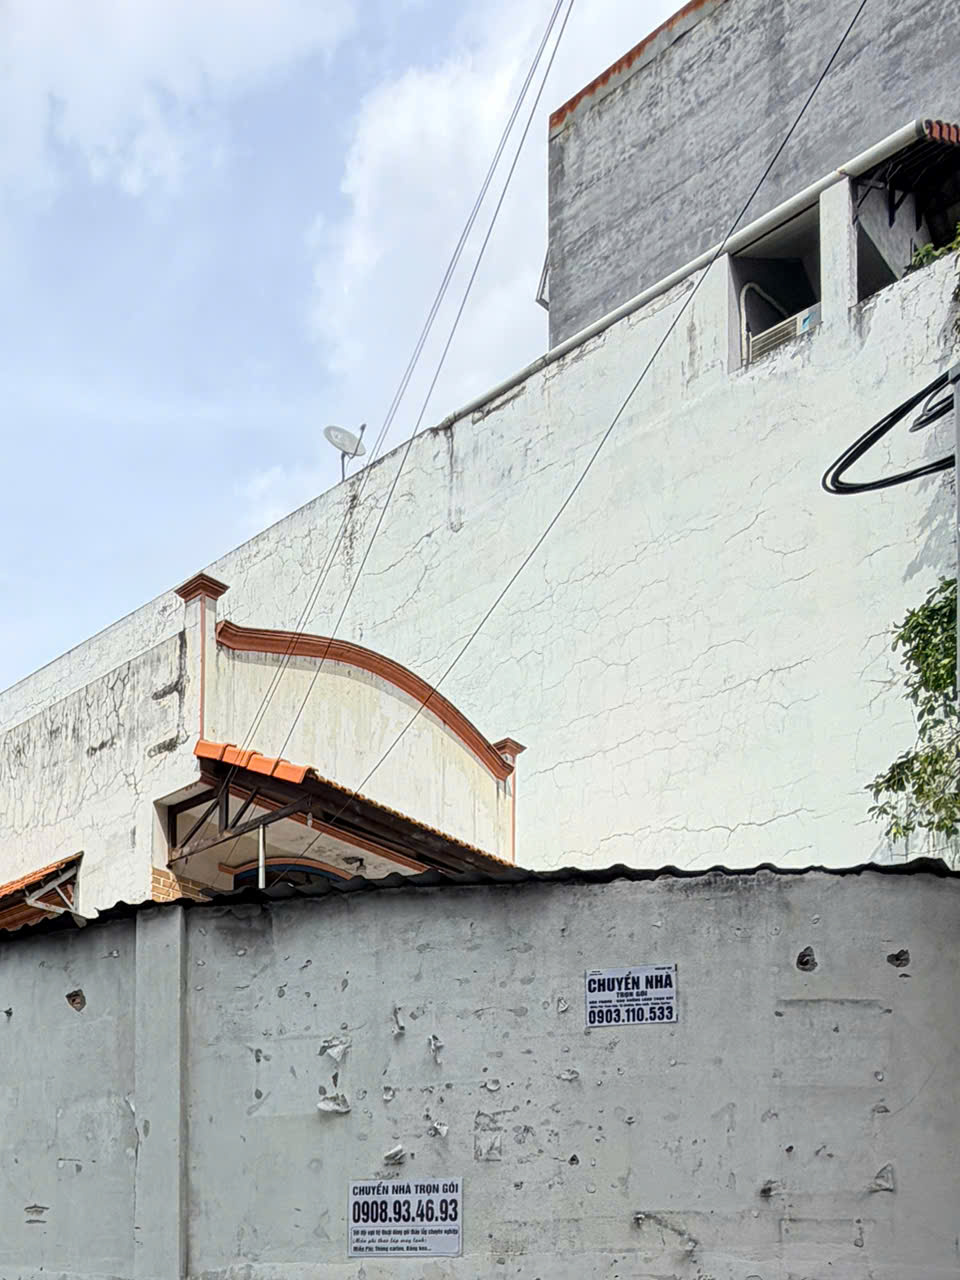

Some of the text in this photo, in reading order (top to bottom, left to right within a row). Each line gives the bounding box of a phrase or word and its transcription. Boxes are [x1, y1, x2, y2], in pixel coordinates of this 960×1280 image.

[645, 971, 673, 990] NHÀ
[588, 1006, 674, 1024] 0903.110.533
[391, 1182, 411, 1195] NHÀ
[414, 1183, 439, 1196] TRỌN
[442, 1181, 459, 1194] GÓI
[352, 1199, 458, 1223] 0908.93.46.93
